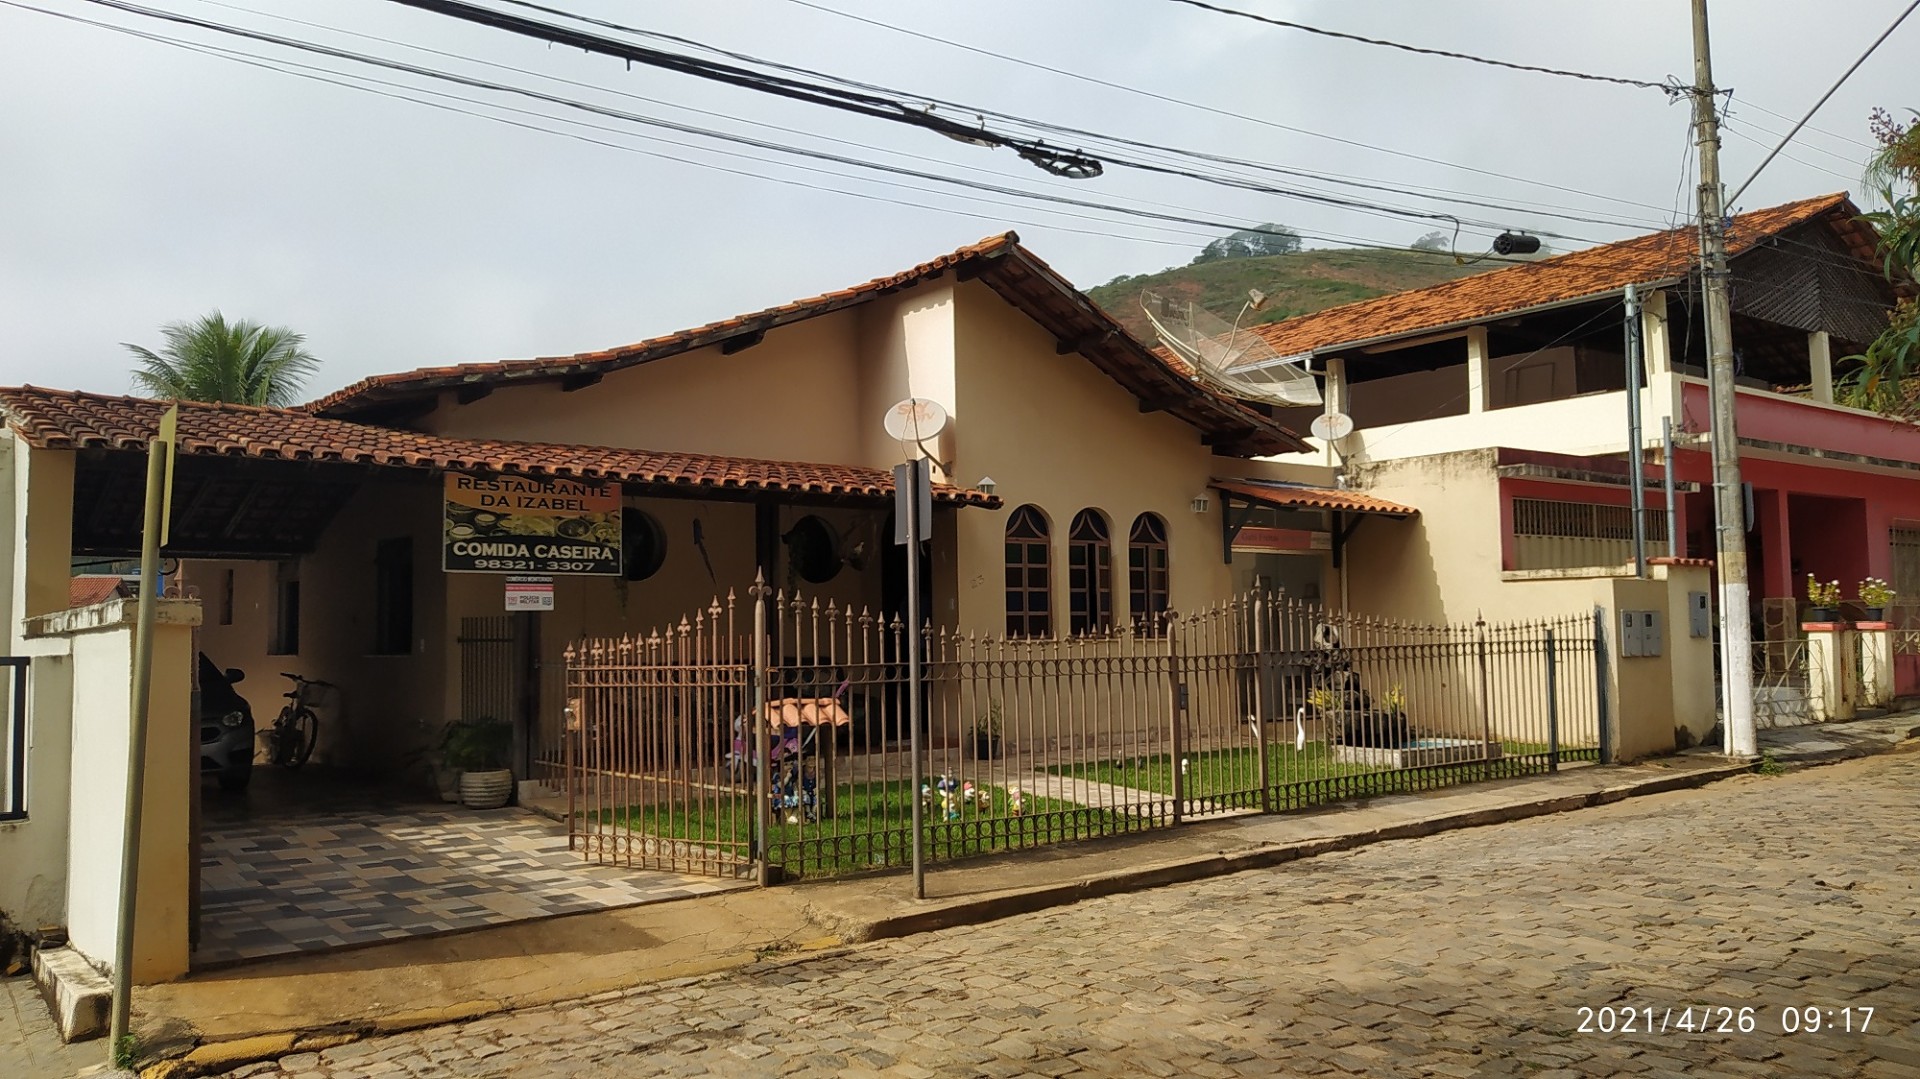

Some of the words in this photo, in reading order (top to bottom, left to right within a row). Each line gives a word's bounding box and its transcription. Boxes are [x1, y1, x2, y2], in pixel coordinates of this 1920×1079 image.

[457, 477, 611, 497] RESTAURANTE
[480, 494, 510, 507] DA
[517, 496, 590, 511] IZABEL
[453, 542, 530, 557] COMIDA
[534, 544, 613, 560] CASEIRA
